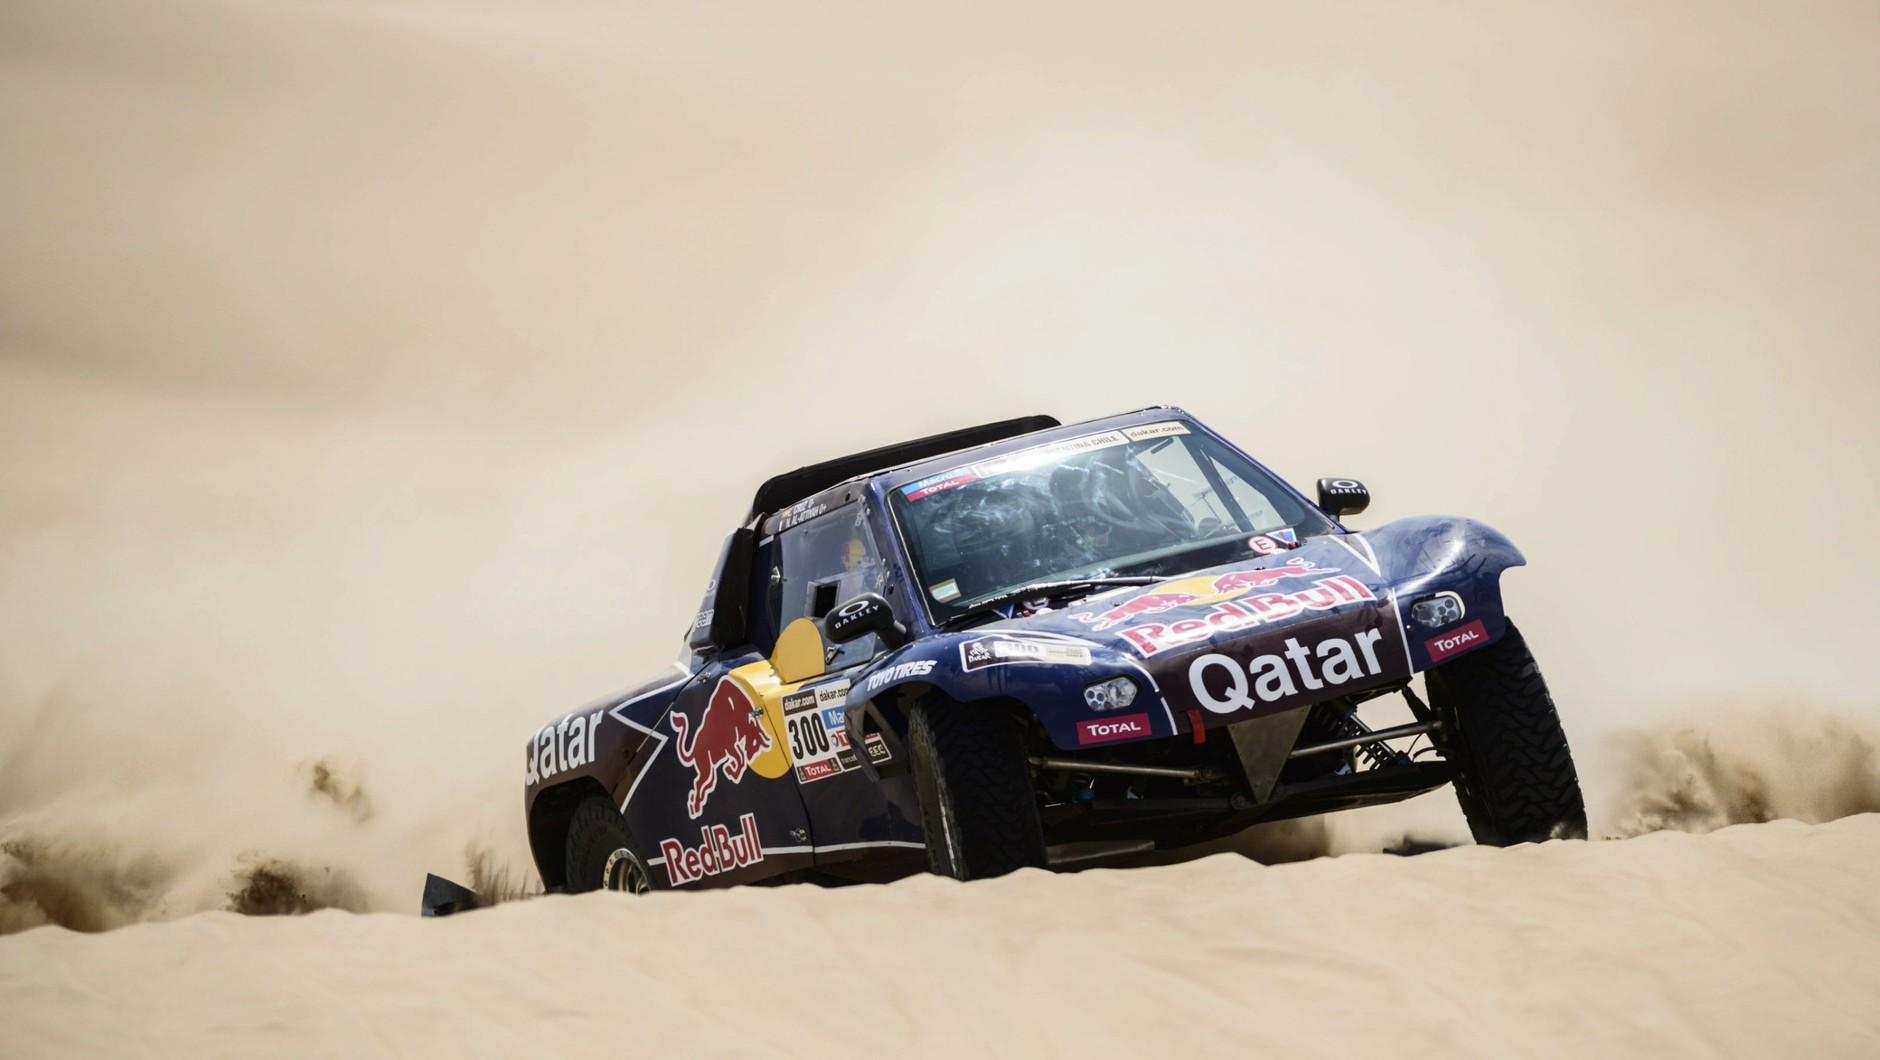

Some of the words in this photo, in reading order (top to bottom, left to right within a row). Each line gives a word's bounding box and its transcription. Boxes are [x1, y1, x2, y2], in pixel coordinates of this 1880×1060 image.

[1093, 435, 1119, 446] CHILE
[1130, 425, 1184, 437] dakar.com
[917, 473, 953, 488] Macro
[1254, 538, 1272, 551] E
[834, 604, 879, 629] OAKLEY
[1117, 602, 1257, 657] Red
[1244, 575, 1376, 623] Bull
[1433, 630, 1479, 652] TOTAL
[867, 666, 895, 691] TOYO
[893, 660, 938, 680] TIRES
[1188, 627, 1383, 714] Qatar
[784, 695, 815, 711] dakar.com
[788, 712, 830, 760] 300
[1087, 721, 1141, 736] TOTAL
[805, 764, 832, 776] TOTAL
[661, 826, 719, 886] Red
[712, 813, 763, 871] Bull
